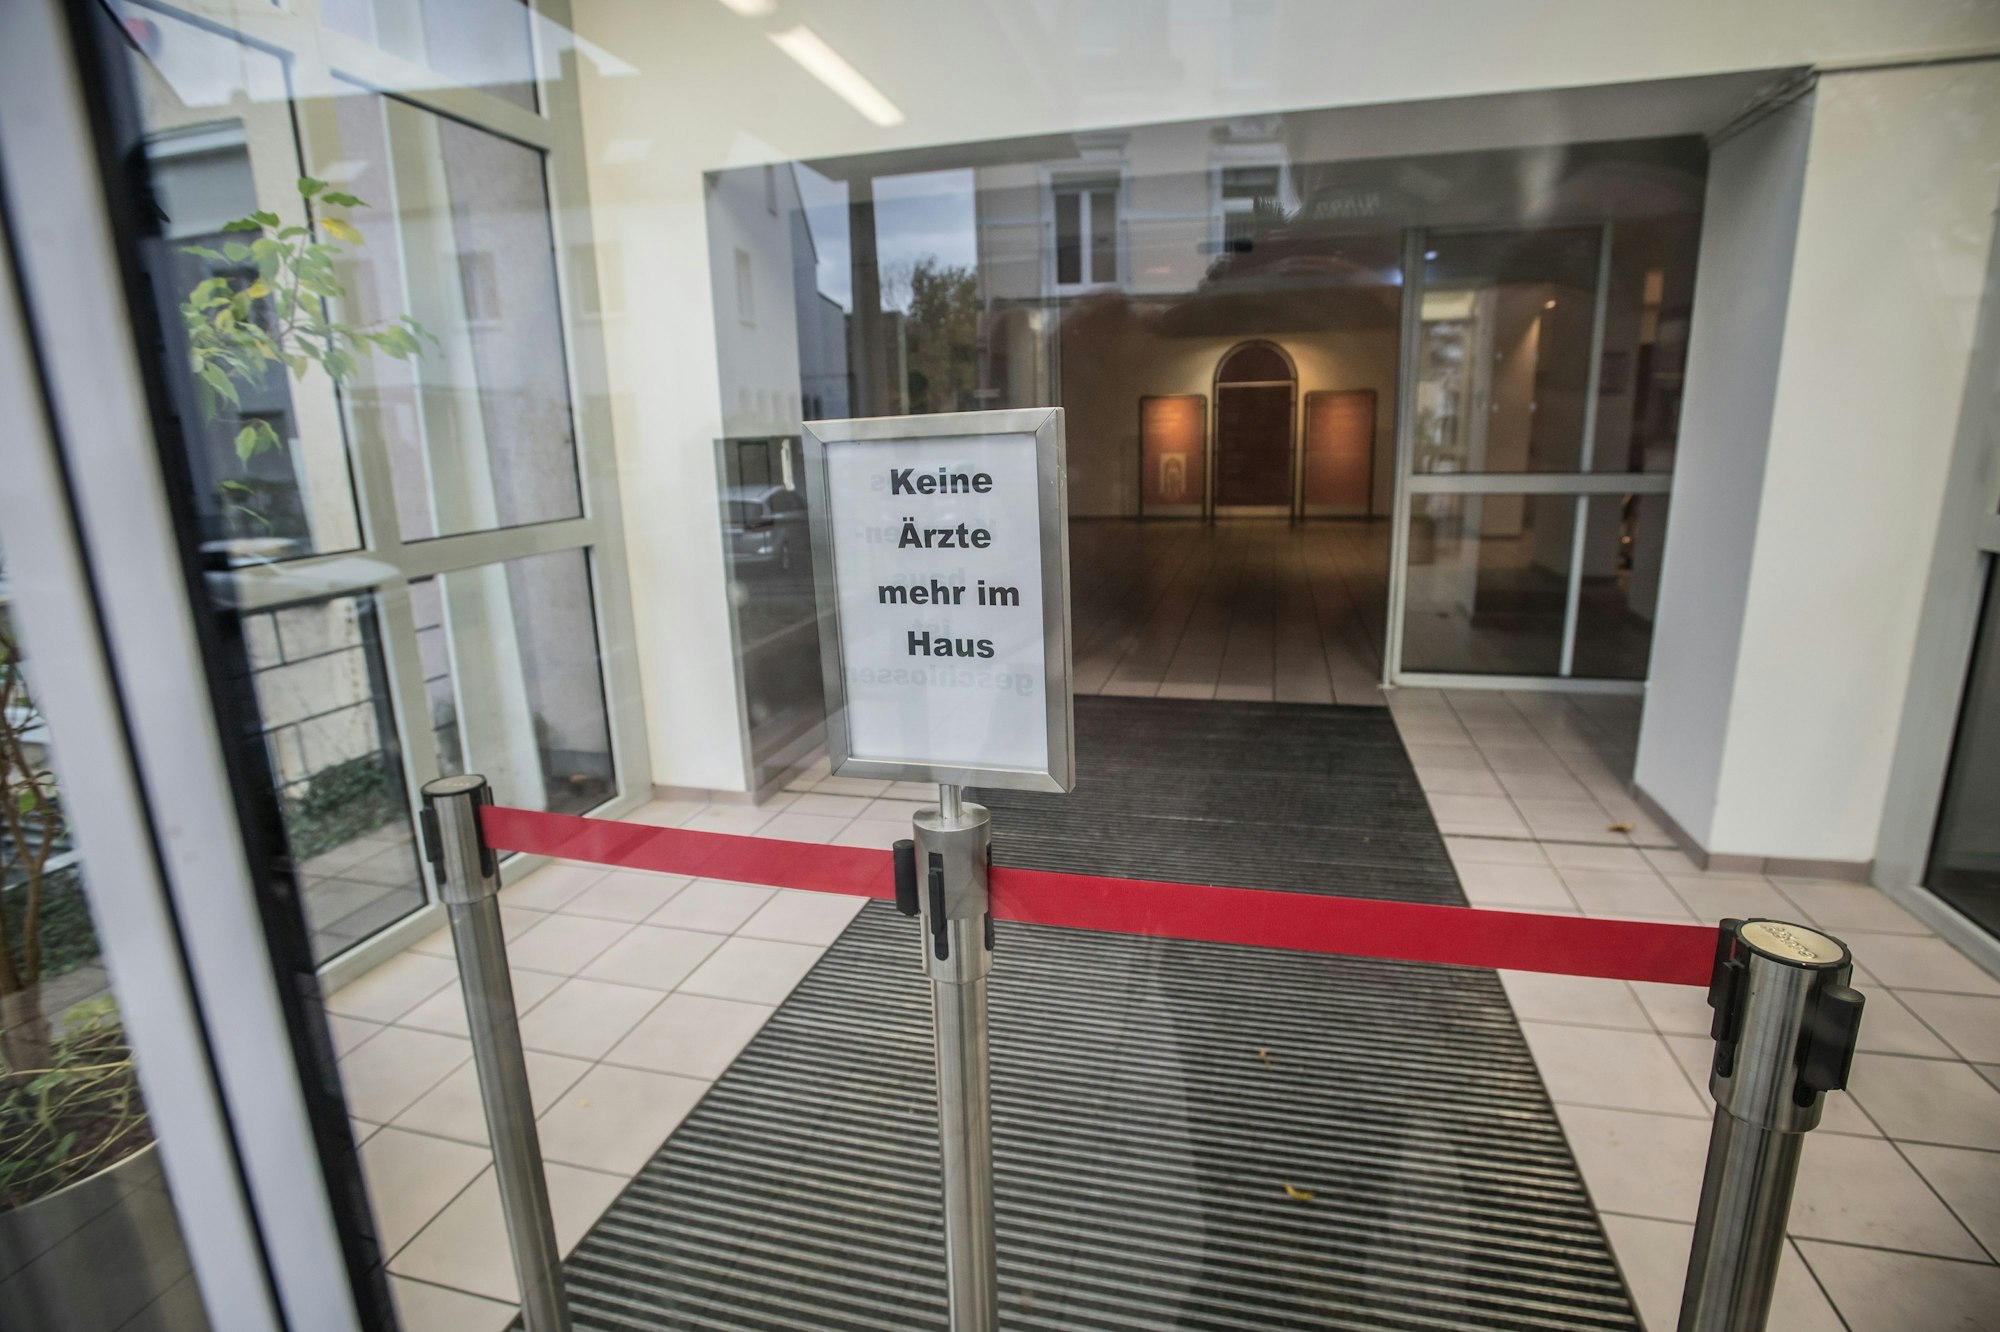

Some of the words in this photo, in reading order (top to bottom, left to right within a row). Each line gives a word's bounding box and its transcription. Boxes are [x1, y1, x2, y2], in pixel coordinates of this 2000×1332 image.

[891, 468, 992, 495] Keine
[899, 517, 991, 548] Ärzte
[879, 580, 965, 604] mehr
[978, 580, 1019, 606] im
[908, 631, 994, 658] Haus
